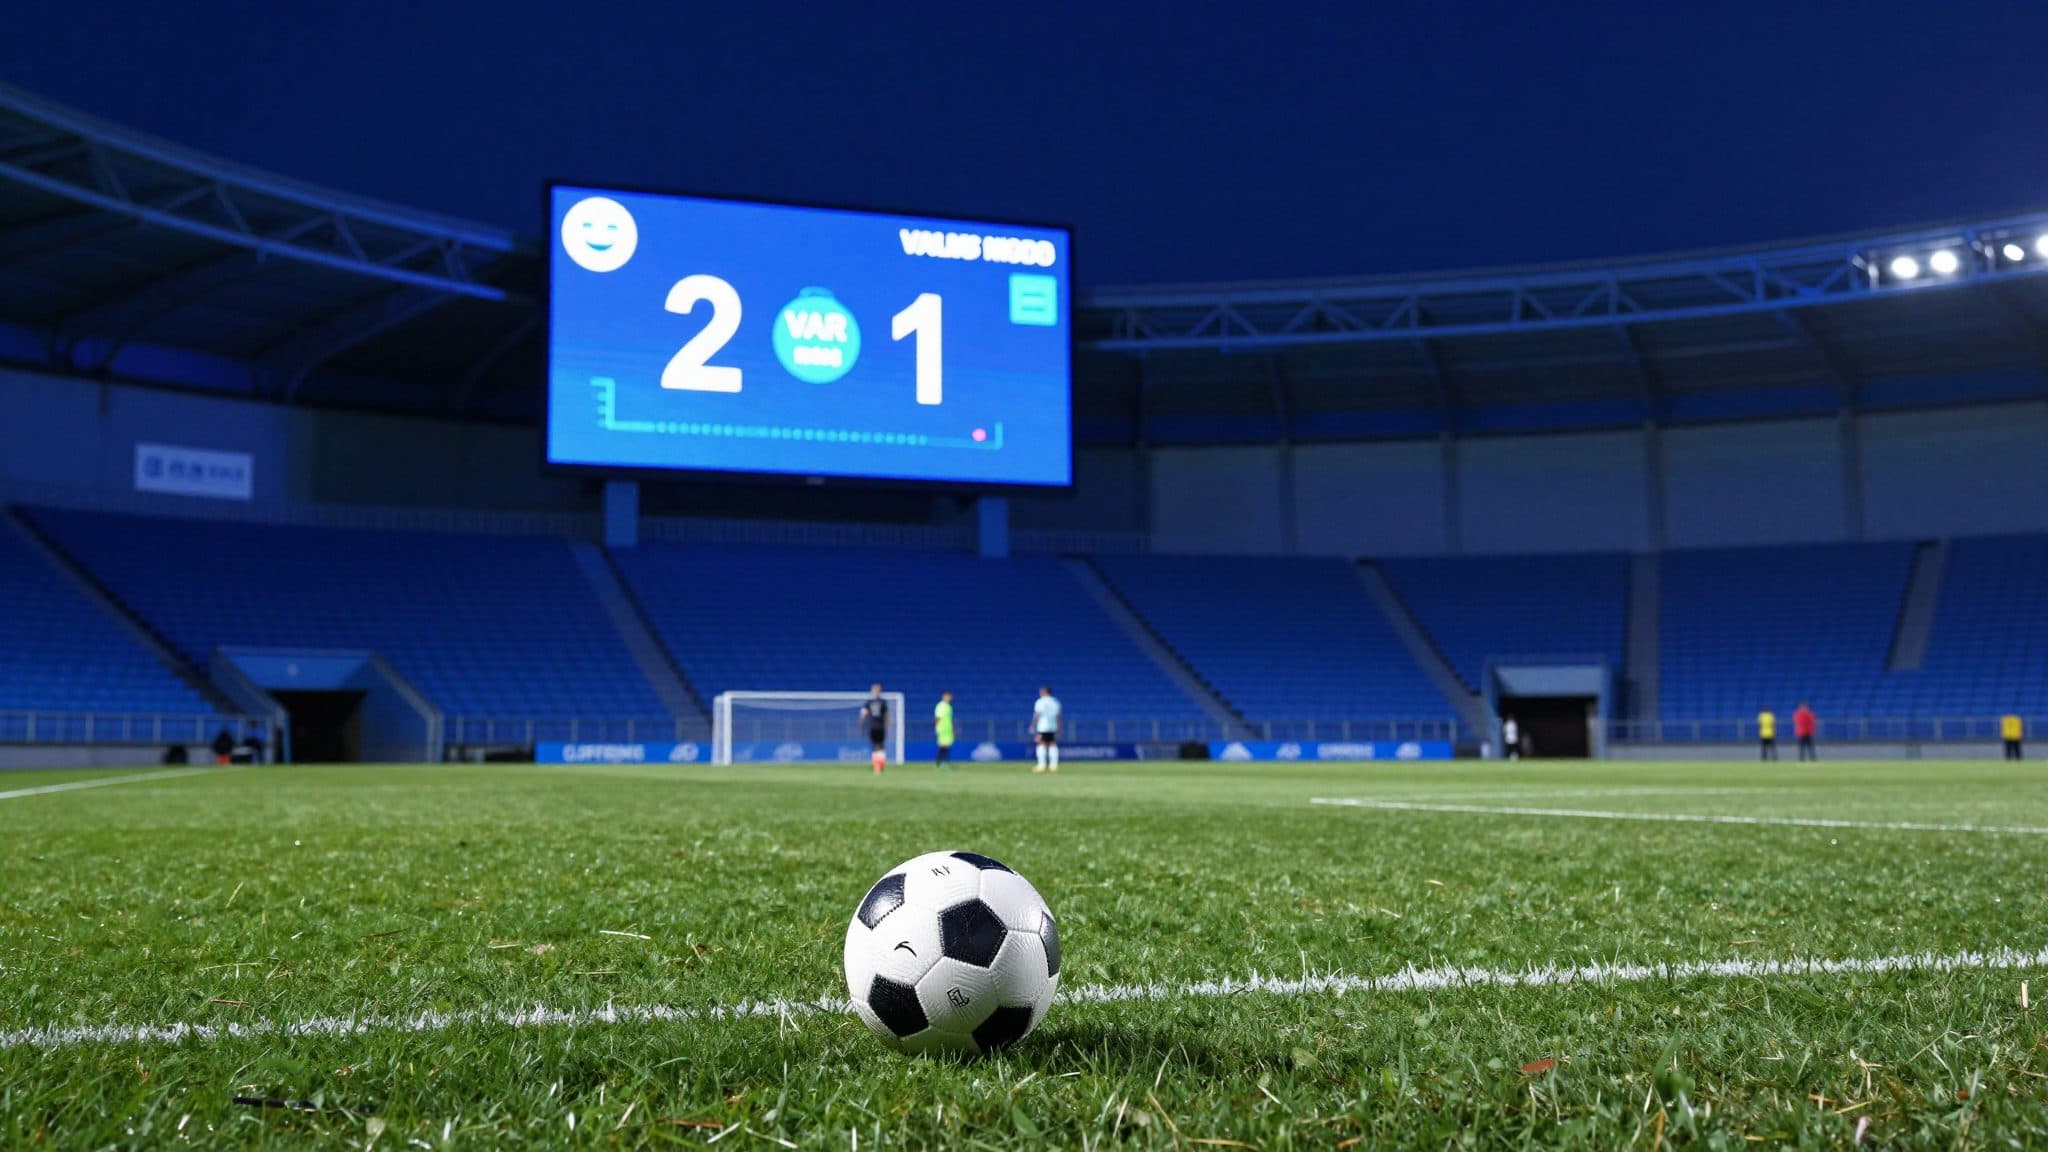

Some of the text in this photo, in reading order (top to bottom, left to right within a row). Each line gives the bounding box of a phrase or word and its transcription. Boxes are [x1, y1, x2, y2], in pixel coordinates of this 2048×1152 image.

[660, 274, 743, 393] 2
[784, 309, 847, 343] VAR
[891, 292, 943, 405] 1
